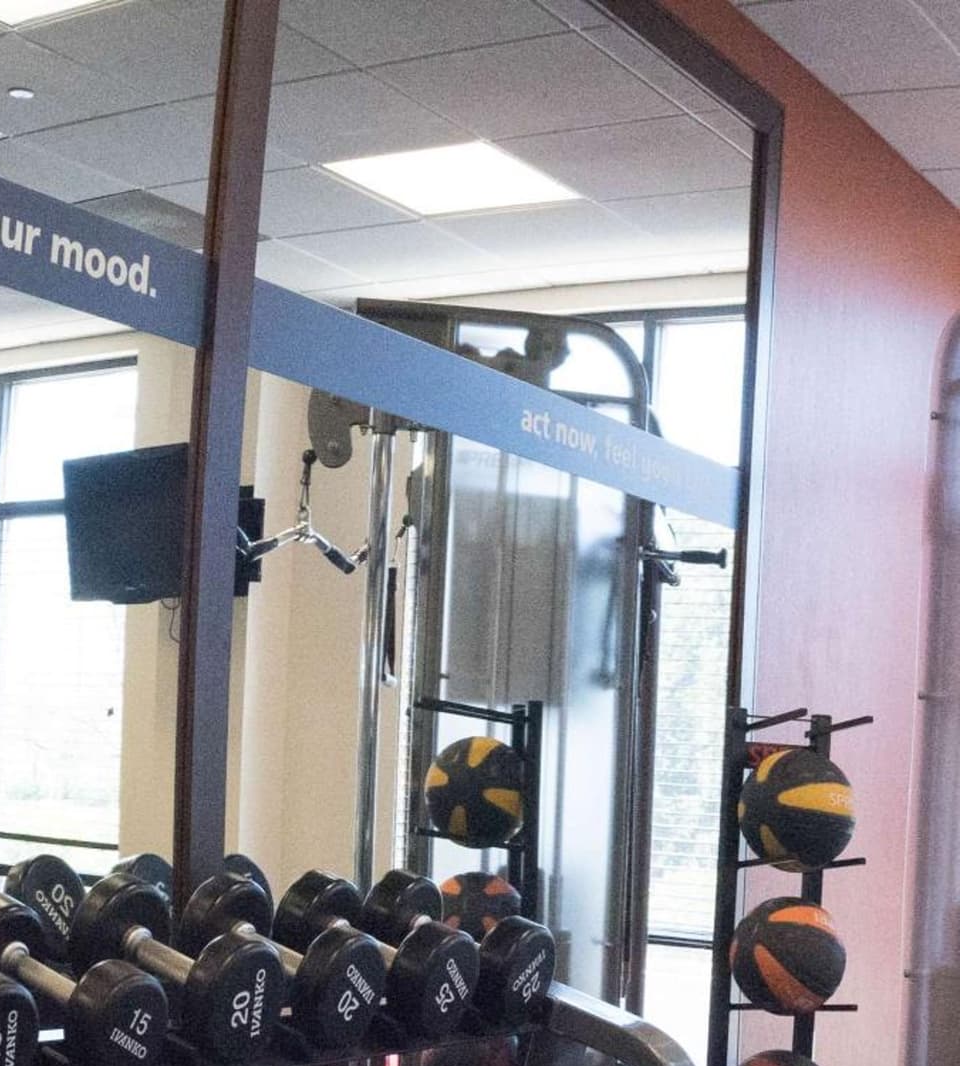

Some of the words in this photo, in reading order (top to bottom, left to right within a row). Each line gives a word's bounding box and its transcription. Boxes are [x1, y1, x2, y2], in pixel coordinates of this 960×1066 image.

[50, 231, 157, 297] mood.
[521, 409, 551, 439] act
[555, 421, 598, 461] now,
[346, 963, 376, 1005] IVANKO
[446, 958, 470, 1001] IVANKO
[512, 949, 547, 993] IVANKO
[522, 971, 541, 1004] 25
[230, 991, 251, 1029] 20
[249, 968, 267, 1039] IVANKO
[337, 990, 360, 1022] 20
[435, 982, 455, 1014] 25
[128, 1007, 153, 1036] 15
[109, 1026, 148, 1060] IVANKO
